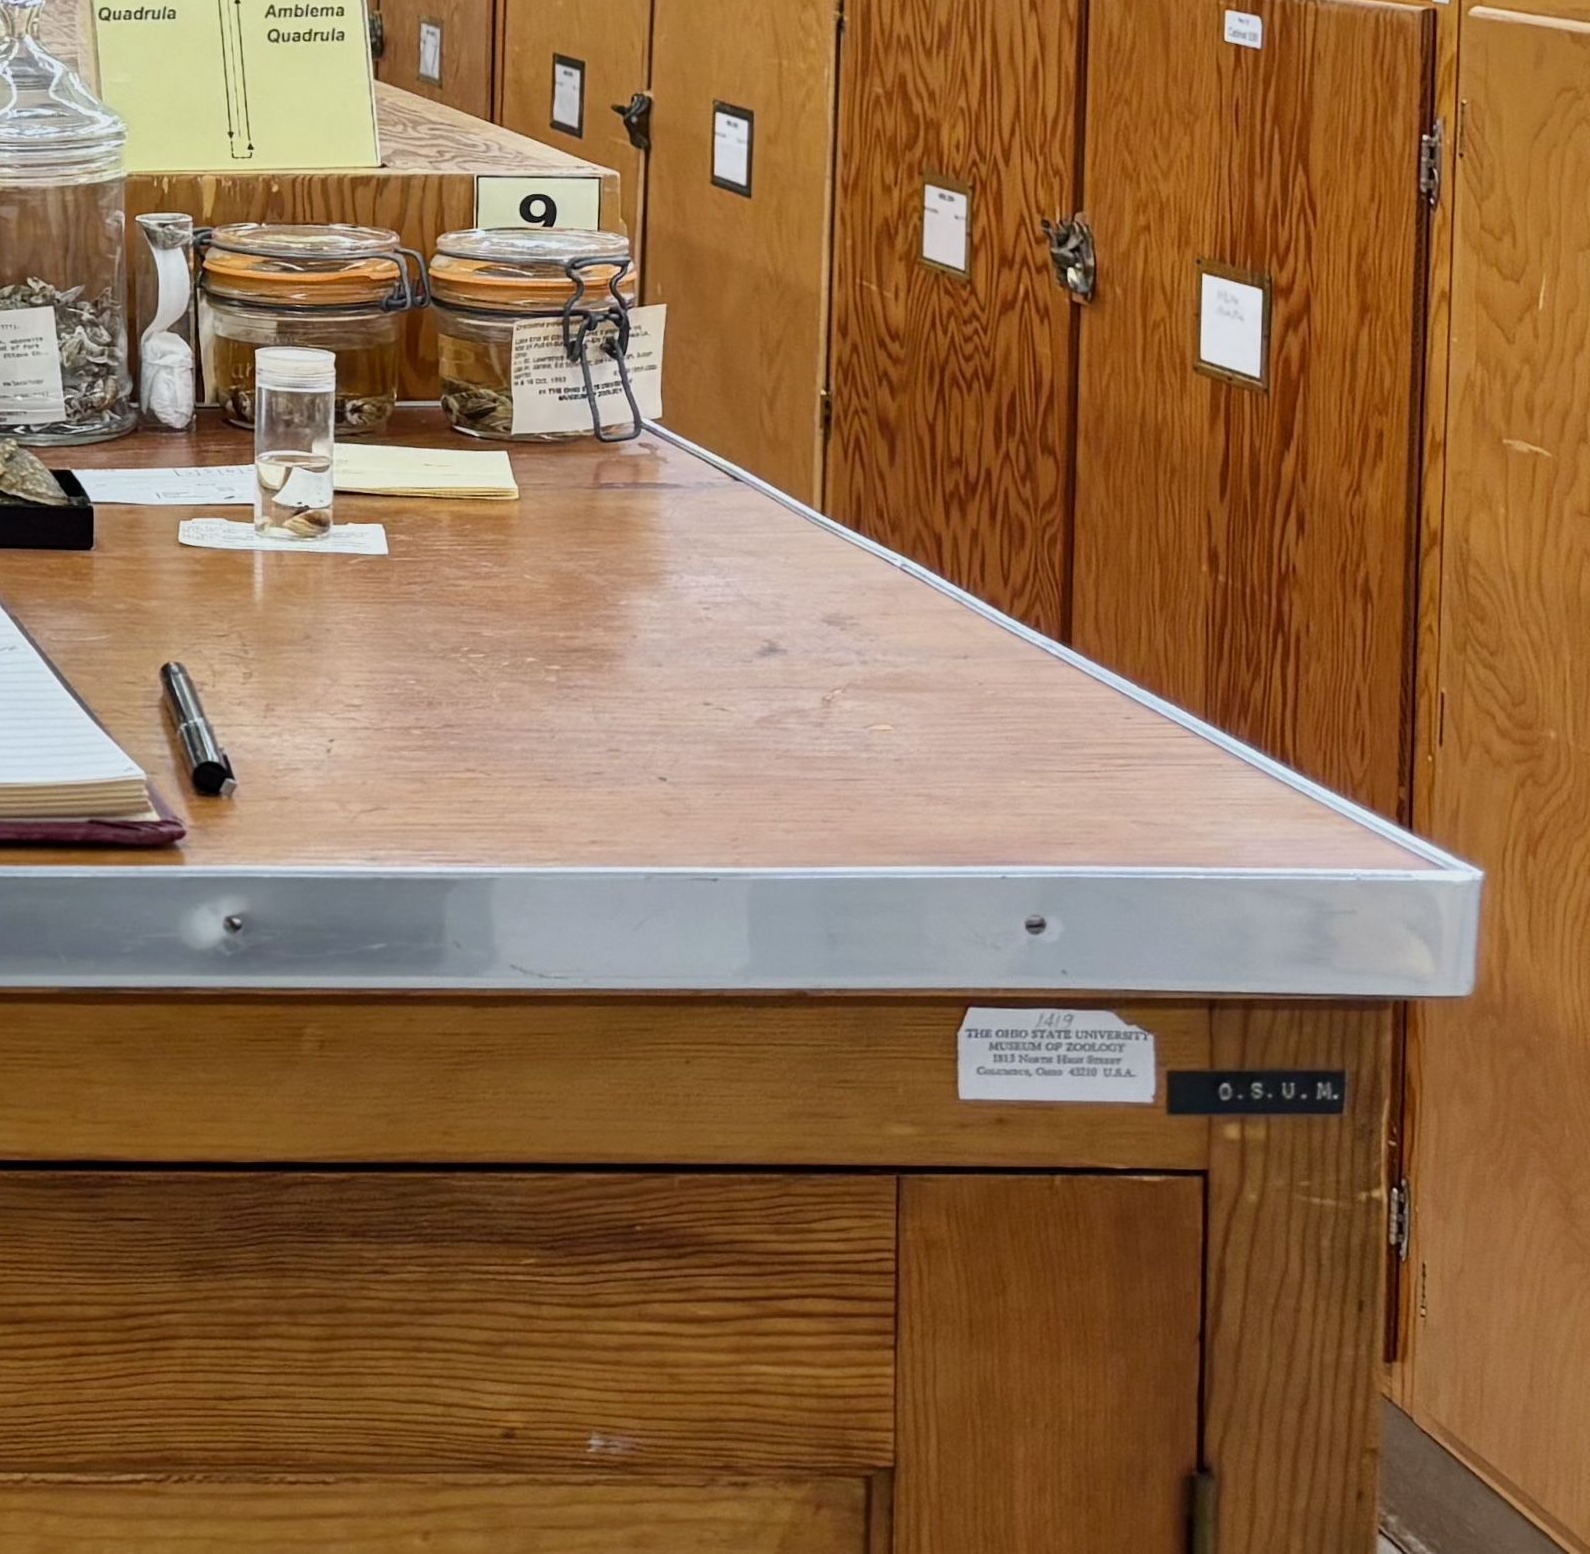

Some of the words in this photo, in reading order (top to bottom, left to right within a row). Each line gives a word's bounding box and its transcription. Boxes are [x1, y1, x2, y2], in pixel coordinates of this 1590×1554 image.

[98, 6, 177, 22] Quadrula
[265, 4, 345, 19] Amblema
[267, 28, 346, 44] Quadrula
[518, 193, 558, 229] 9
[1035, 1013, 1075, 1029] 1419
[964, 1028, 992, 1040] THE
[995, 1028, 1029, 1039] OHIO
[1031, 1029, 1072, 1040] STATE
[1075, 1030, 1149, 1041] UNIVERSITY
[988, 1041, 1043, 1052] MUSEUM
[1045, 1042, 1063, 1052] OF
[1065, 1042, 1126, 1053] ZOOLOGY
